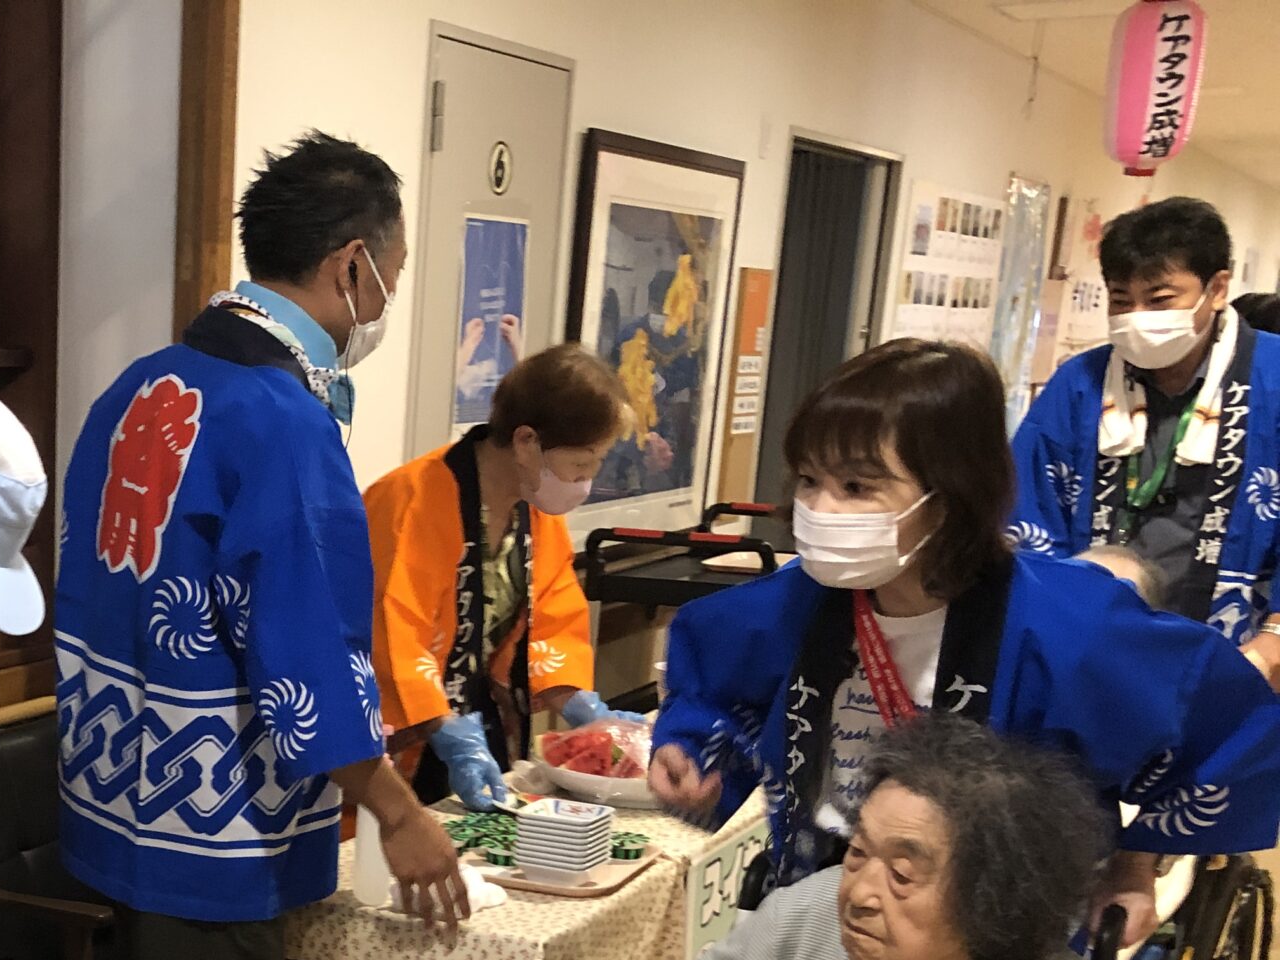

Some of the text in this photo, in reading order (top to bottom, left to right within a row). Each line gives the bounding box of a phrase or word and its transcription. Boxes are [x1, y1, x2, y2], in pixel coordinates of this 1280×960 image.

[1139, 13, 1191, 158] ケアタウン成増
[1195, 381, 1252, 564] ケアタウン成増
